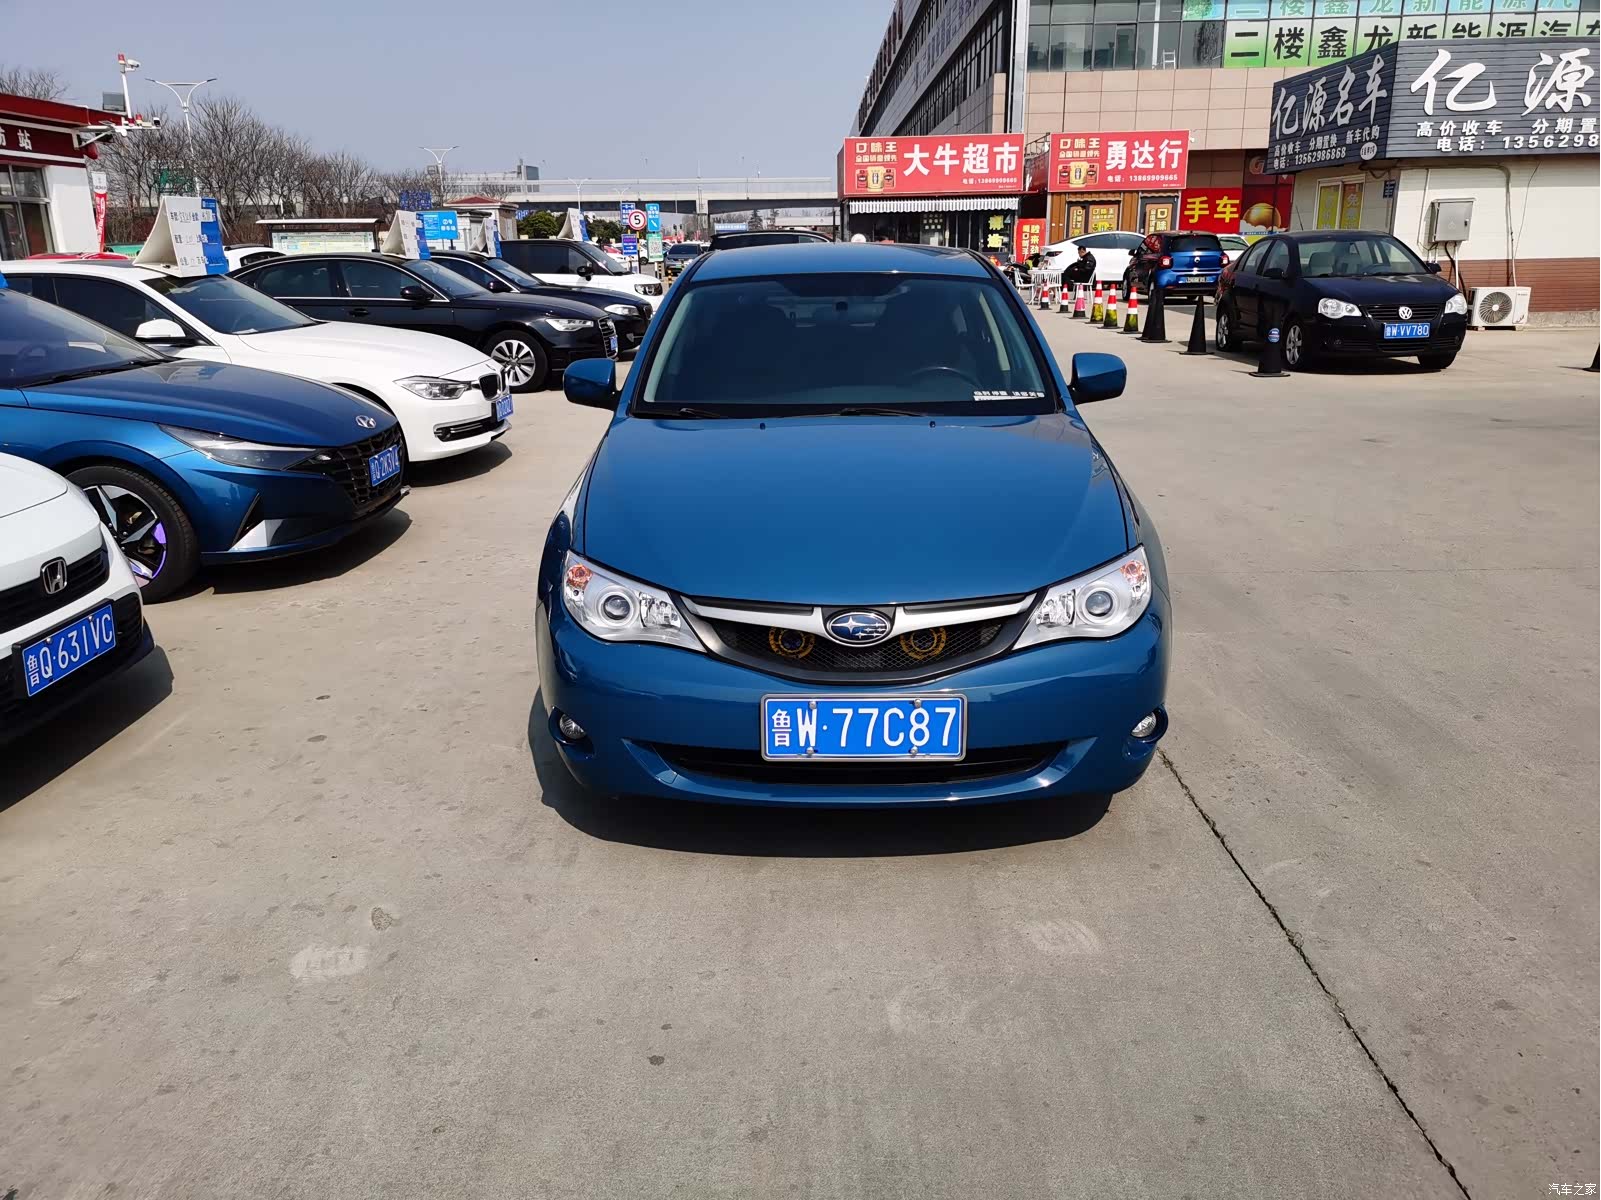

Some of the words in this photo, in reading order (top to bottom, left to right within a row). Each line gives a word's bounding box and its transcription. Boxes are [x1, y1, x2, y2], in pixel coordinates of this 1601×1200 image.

[1410, 47, 1595, 117] 亿源
[1272, 53, 1388, 141] 亿源名车
[1274, 141, 1301, 158] 高价收车
[1308, 133, 1338, 151] 分期置换
[1345, 124, 1380, 145] 新车代购
[1416, 120, 1503, 137] 高价收车
[1531, 117, 1597, 135] 分期置
[855, 141, 898, 154] 口味王
[1060, 137, 1101, 149] 口味王
[1105, 139, 1183, 171] 勇达行
[1295, 146, 1347, 166] 13562986868
[1502, 134, 1599, 150] 1356298
[903, 141, 1020, 177] 大牛超市
[634, 216, 640, 224] 5
[1183, 195, 1240, 224] 手车
[771, 706, 957, 748] 鲁W·77C87
